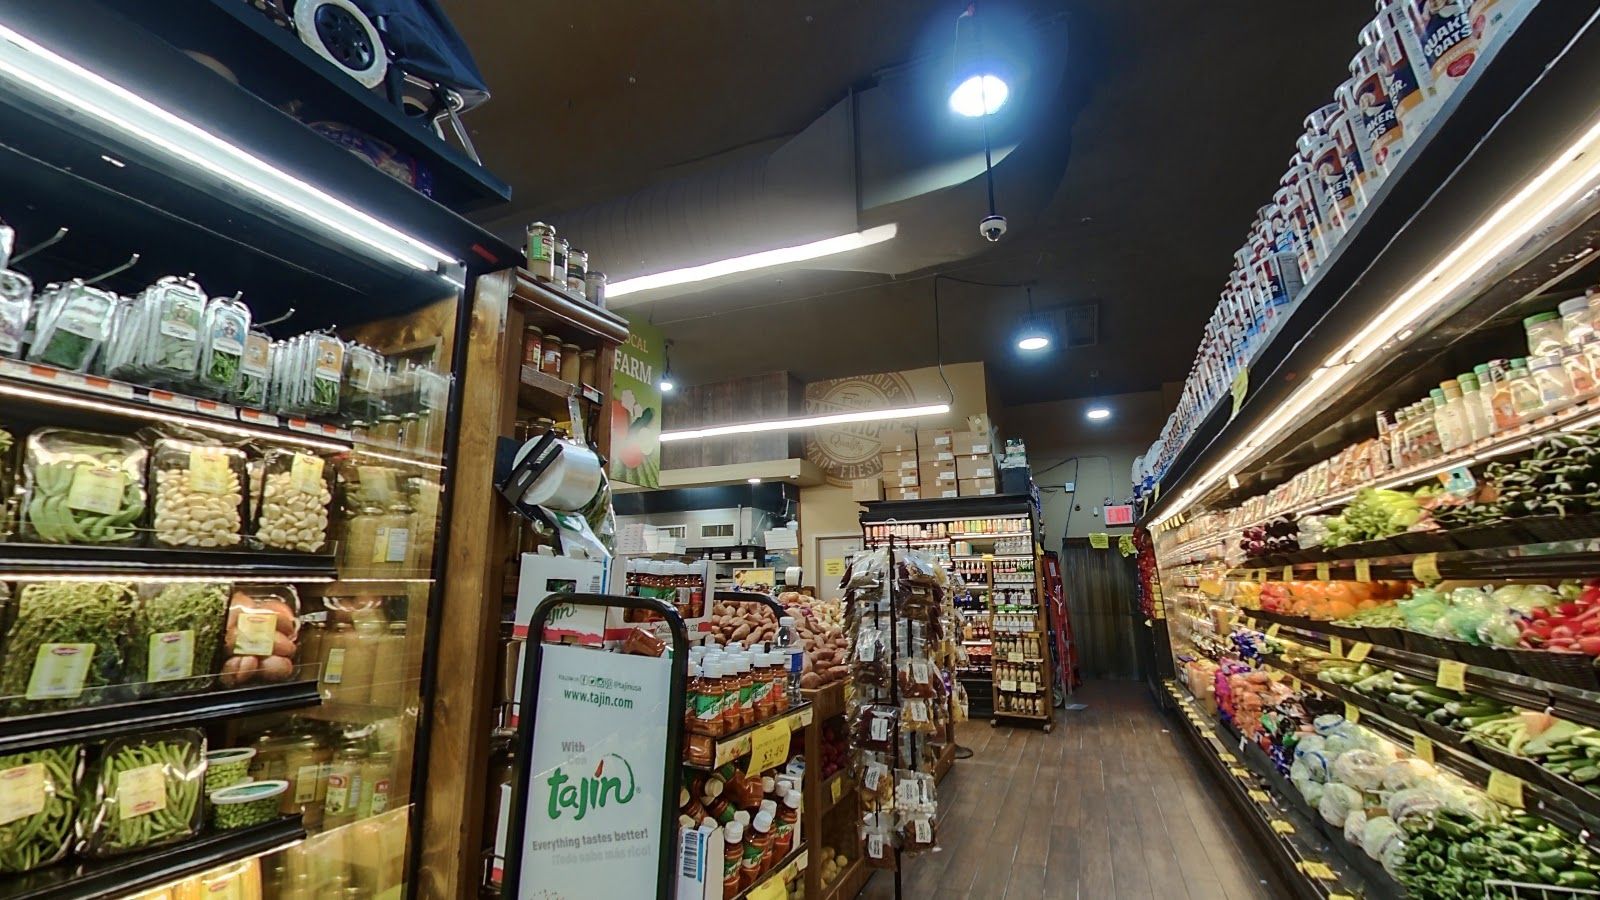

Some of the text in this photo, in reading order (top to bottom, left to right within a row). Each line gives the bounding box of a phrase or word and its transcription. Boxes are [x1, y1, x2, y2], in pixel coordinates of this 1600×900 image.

[1424, 13, 1471, 56] QUAKE
[1434, 25, 1473, 57] OATS
[625, 334, 648, 354] OCAL
[614, 349, 652, 385] FARM
[840, 456, 883, 478] FRESH
[564, 689, 633, 709] www.tajin.com
[561, 741, 585, 753] With
[532, 828, 649, 852] Everything tastes better!
